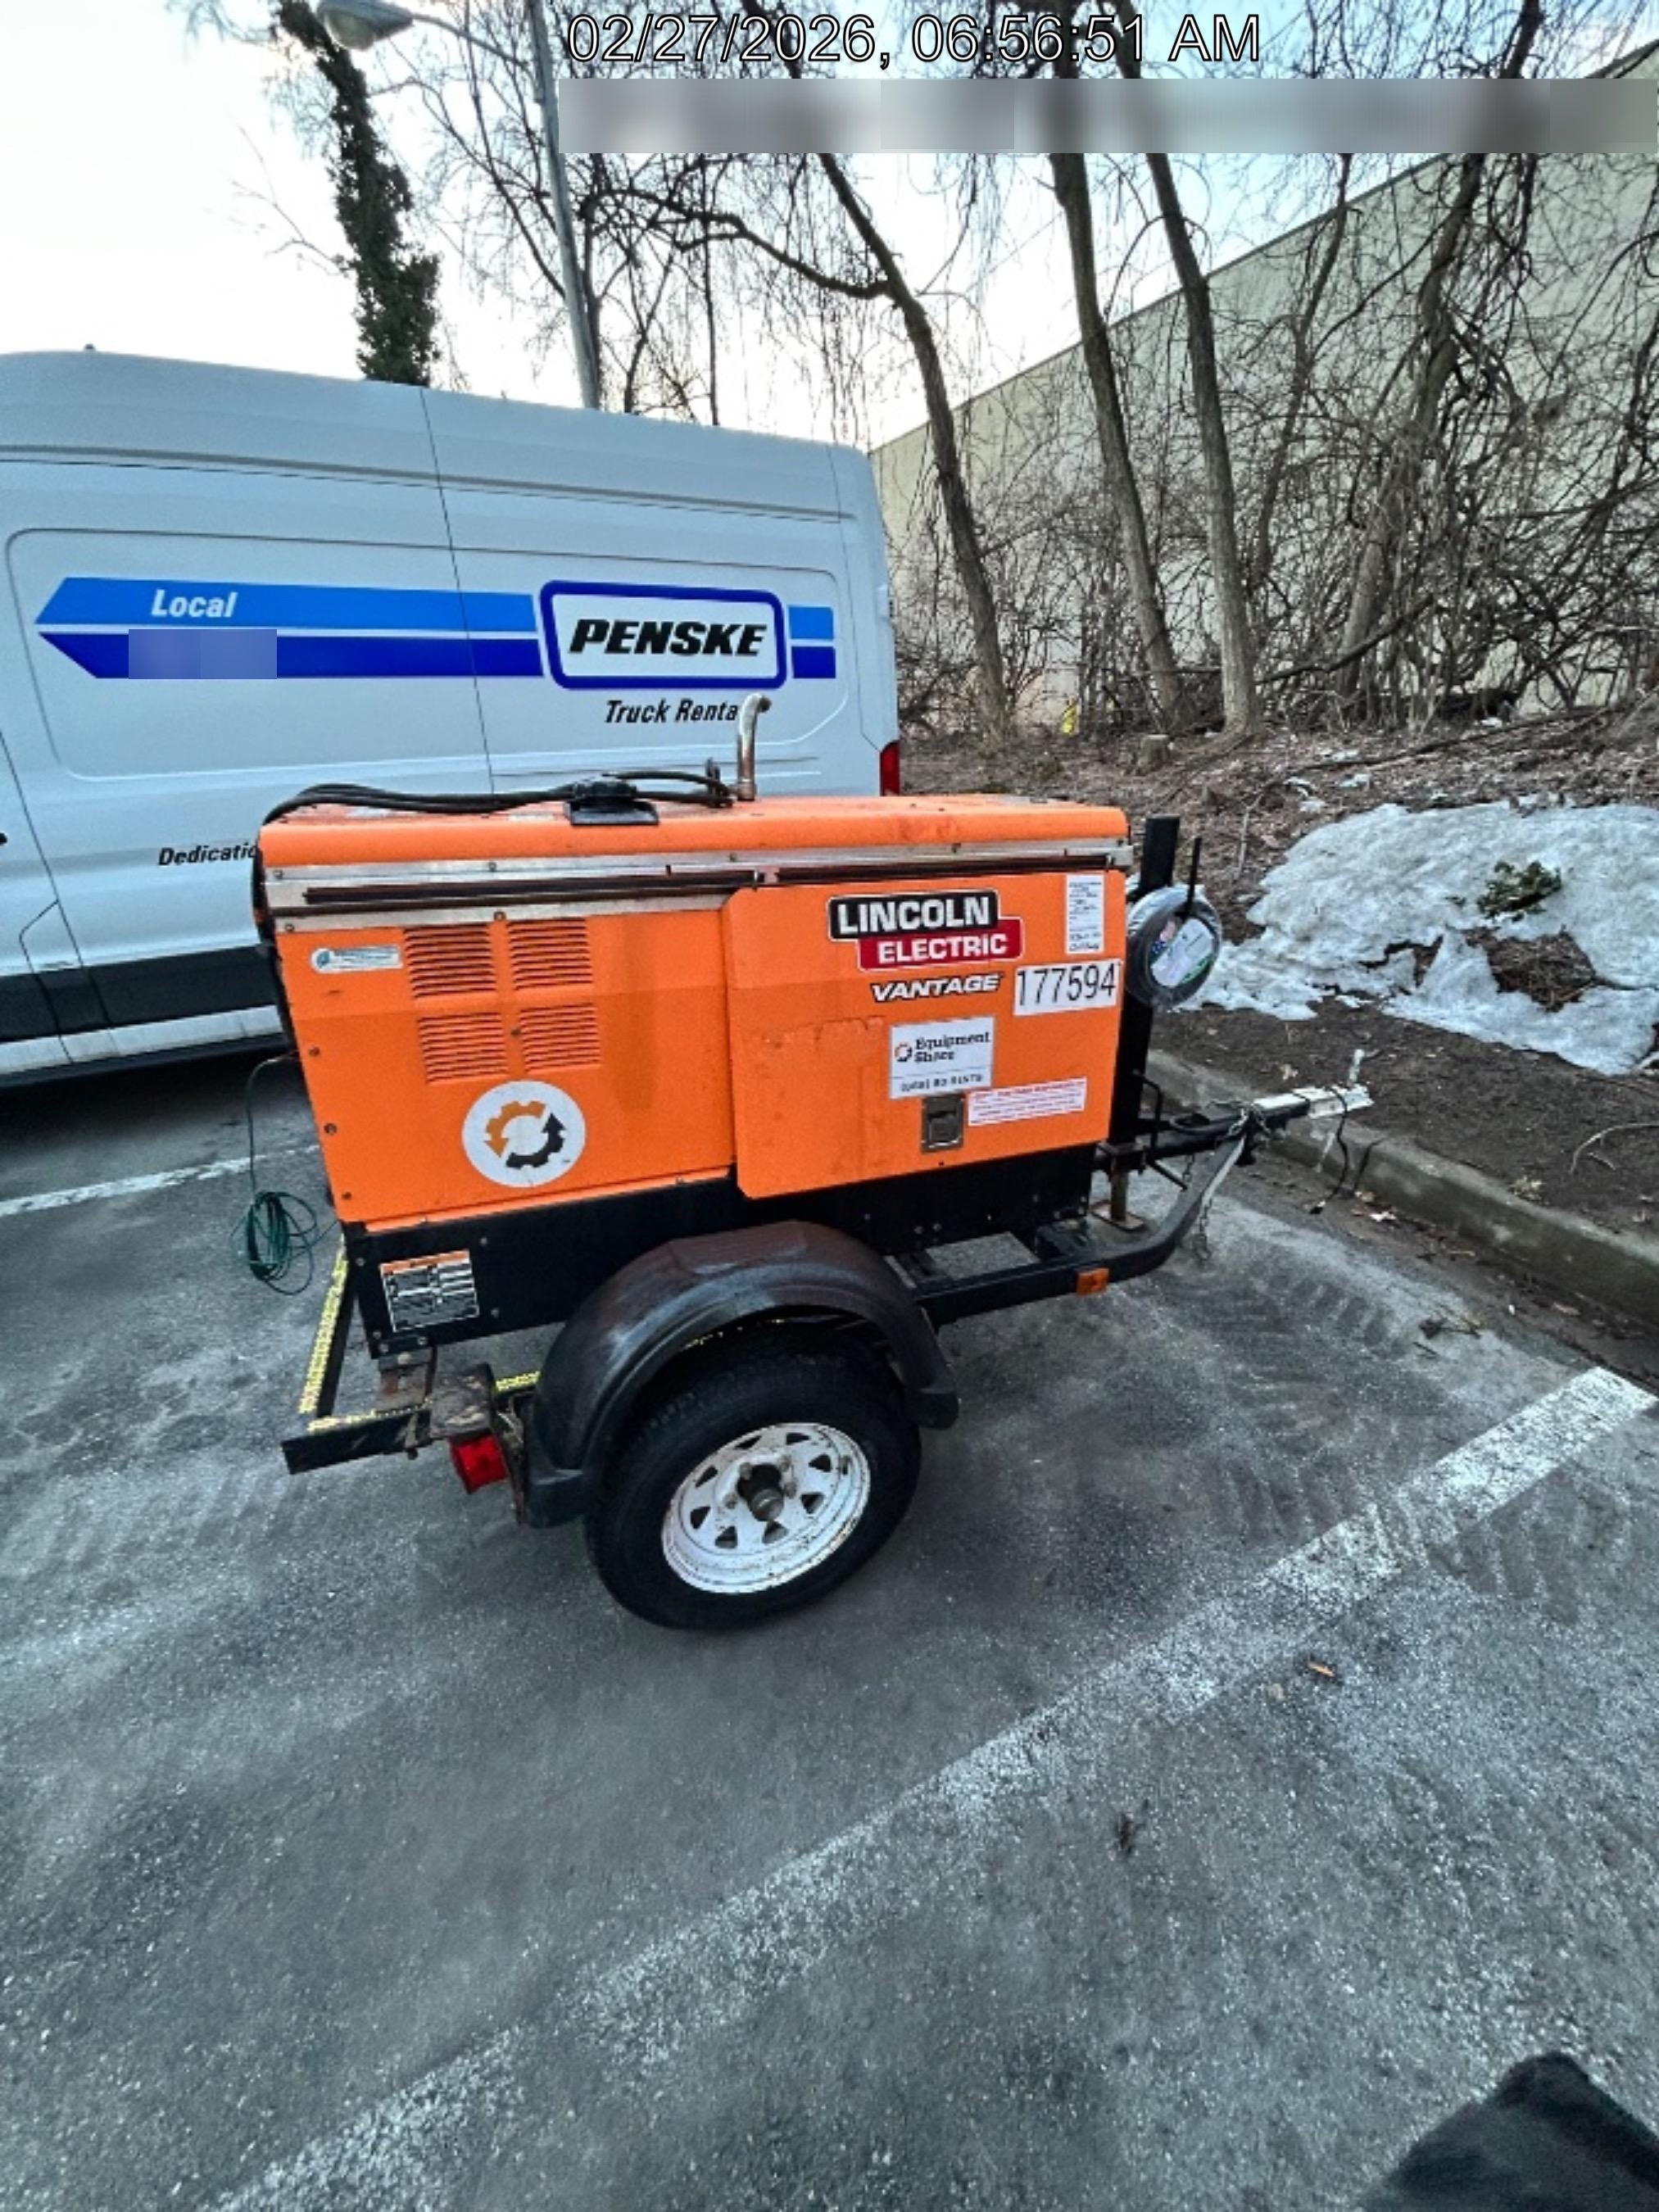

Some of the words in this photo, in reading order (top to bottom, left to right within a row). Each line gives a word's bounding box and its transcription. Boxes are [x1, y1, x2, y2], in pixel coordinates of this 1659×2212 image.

[151, 589, 238, 619] Local
[569, 619, 767, 656] PENSKE
[605, 698, 670, 723] Truck
[674, 698, 738, 722] Renta
[157, 841, 256, 866] Dedicatio
[837, 896, 990, 935] LINCOLN
[877, 933, 1009, 965] ELECTRIC
[871, 972, 1002, 1003] VANTAGE
[1018, 963, 1116, 1006] 177594
[915, 1031, 990, 1050] Equipment
